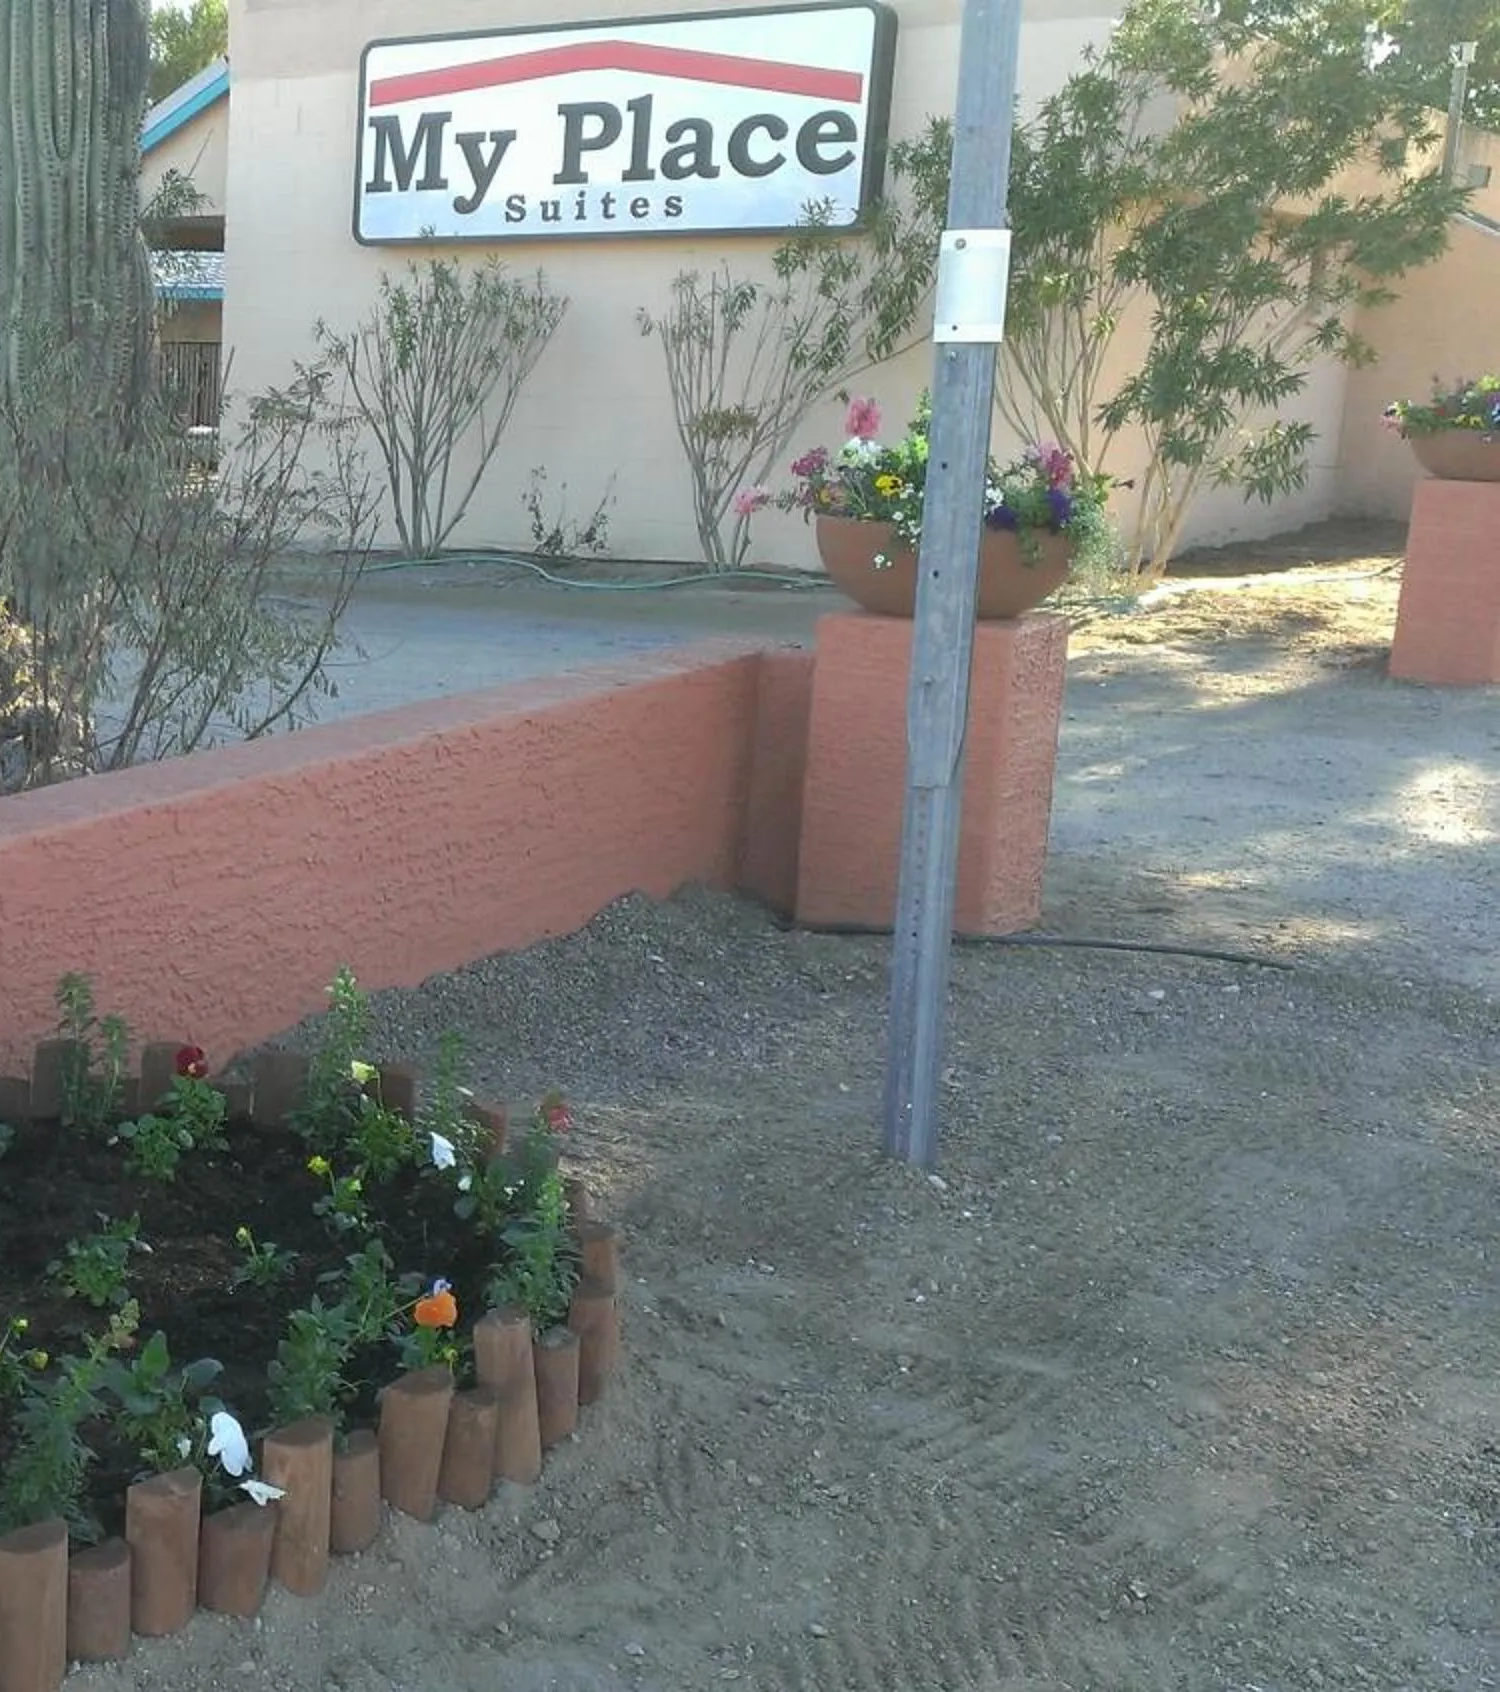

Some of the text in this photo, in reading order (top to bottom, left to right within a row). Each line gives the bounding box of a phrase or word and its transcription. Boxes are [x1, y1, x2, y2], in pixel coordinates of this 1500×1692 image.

[365, 94, 858, 214] My Place
[505, 190, 683, 222] Suites
